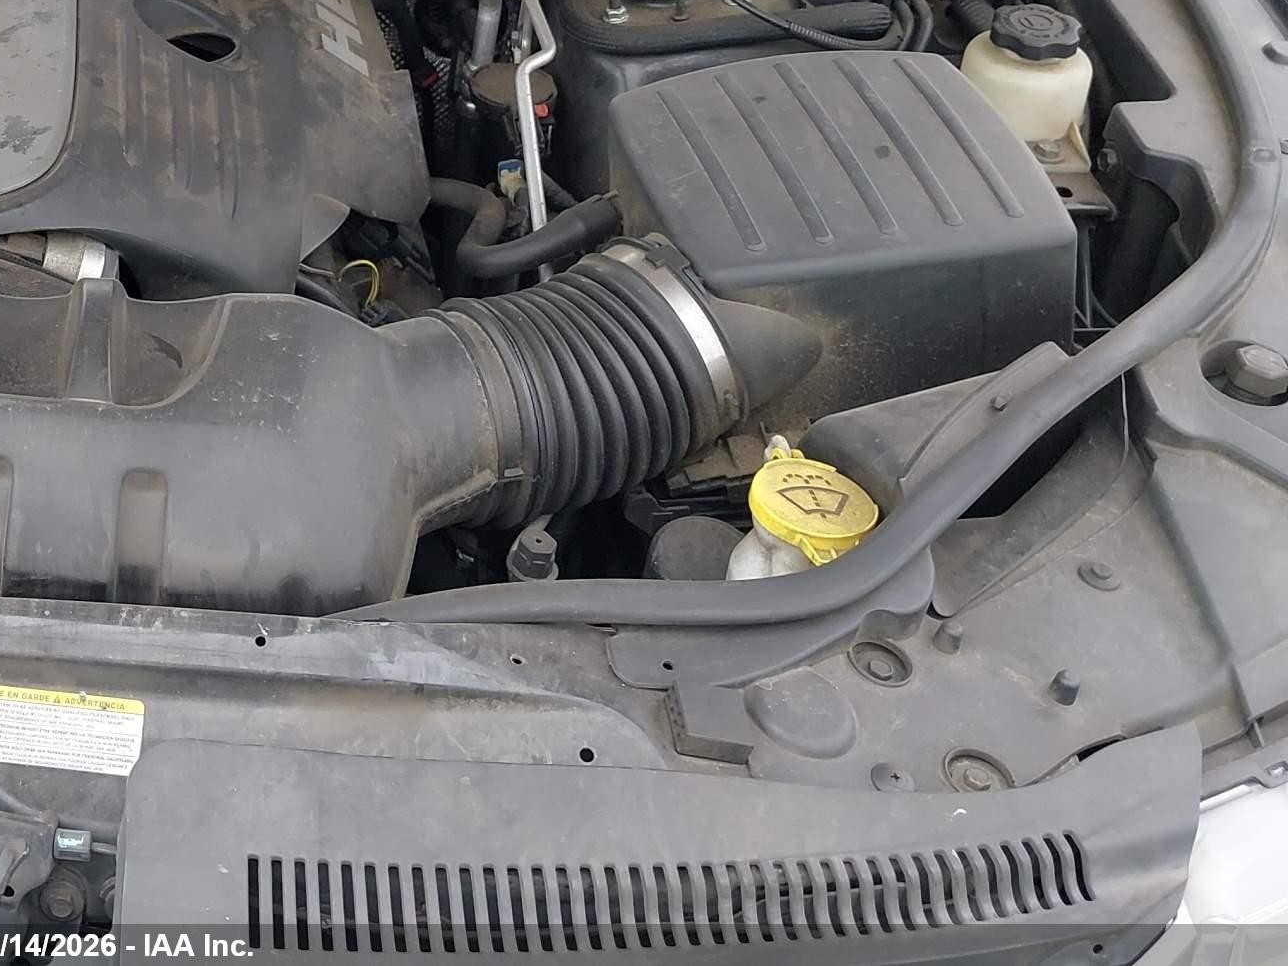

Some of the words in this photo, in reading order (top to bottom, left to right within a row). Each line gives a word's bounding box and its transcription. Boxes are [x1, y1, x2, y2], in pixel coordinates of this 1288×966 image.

[7, 690, 19, 699] EN
[21, 692, 51, 702] GARDE
[64, 696, 126, 711] ADVERTENCIA
